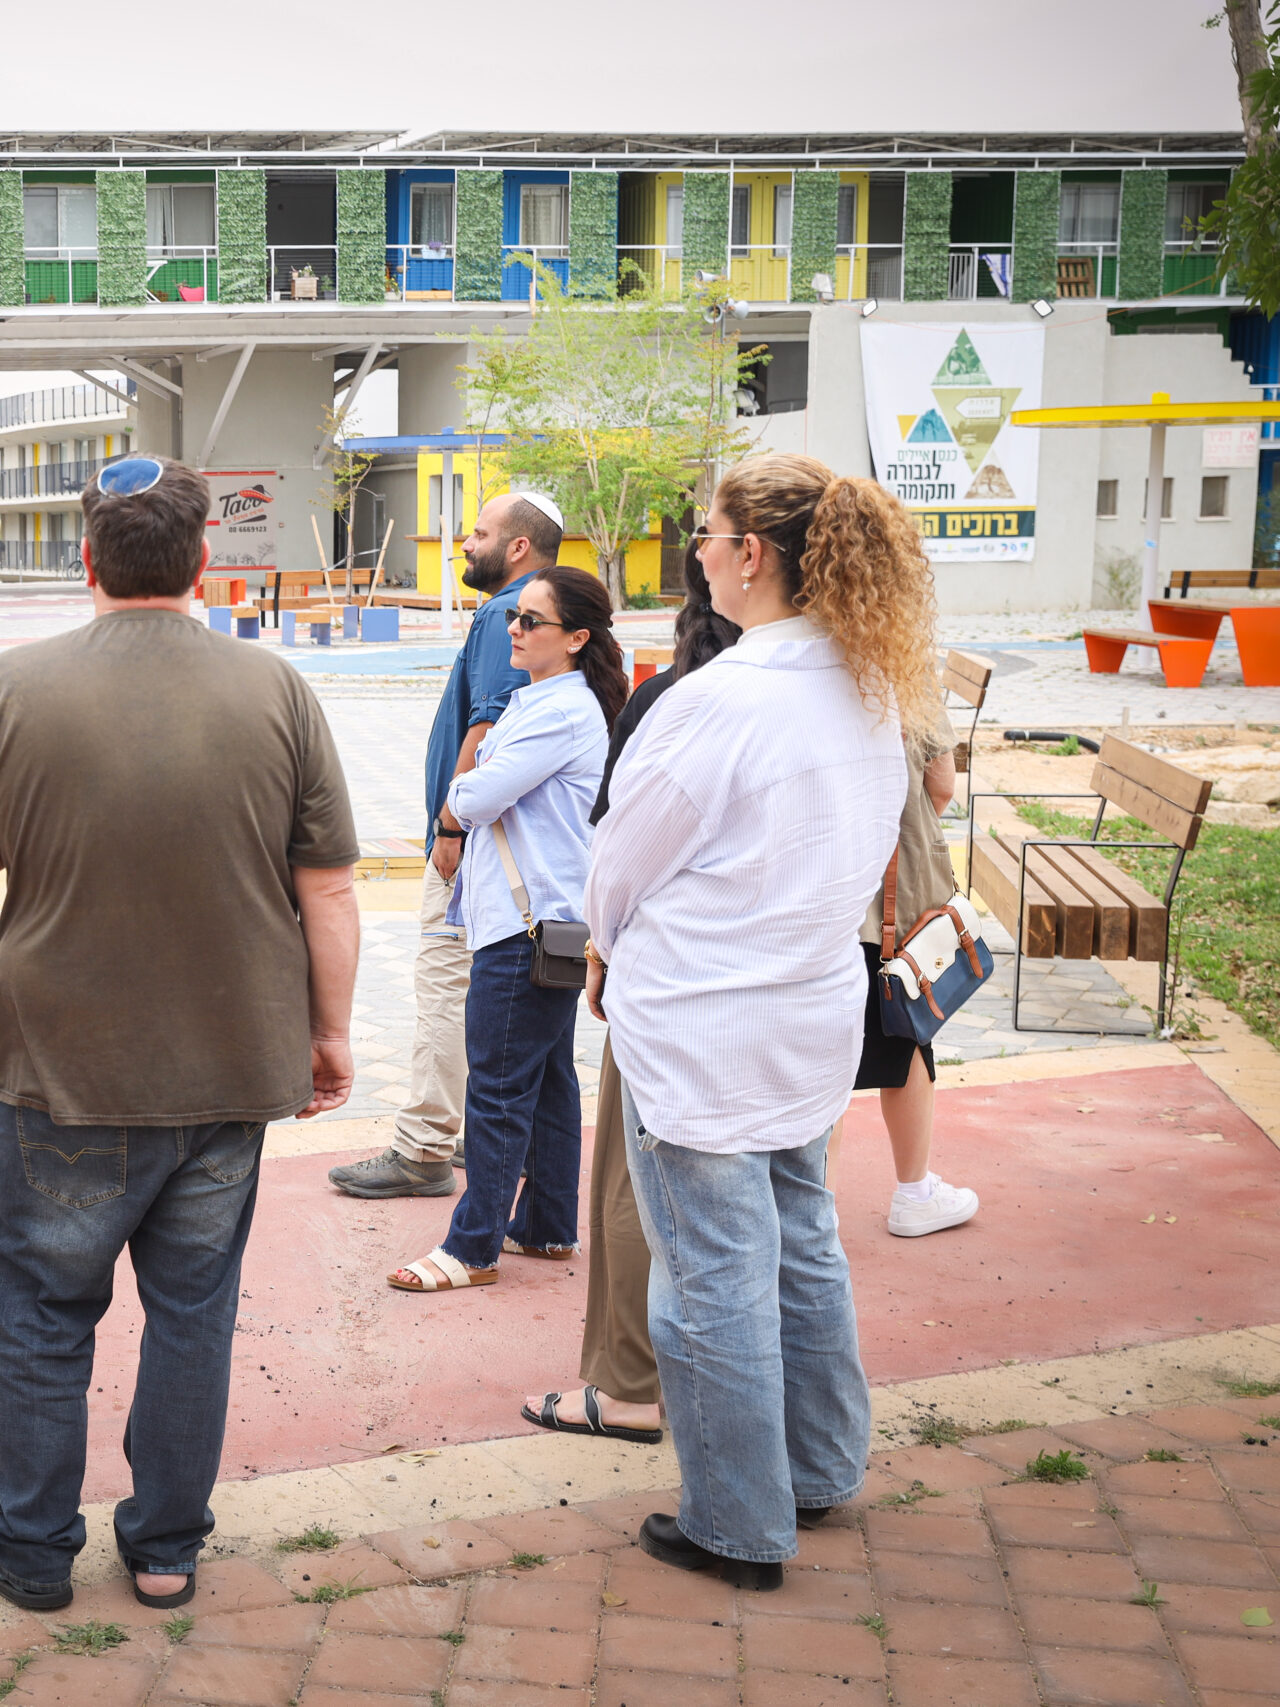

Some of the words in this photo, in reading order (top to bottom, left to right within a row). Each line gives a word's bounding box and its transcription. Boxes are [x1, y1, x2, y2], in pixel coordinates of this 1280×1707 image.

[887, 450, 941, 480] לגבורה
[897, 449, 930, 462] איילים
[938, 450, 958, 462] כנס
[897, 483, 955, 503] ותקומה
[219, 492, 264, 518] Taco
[946, 513, 1019, 536] ברוכים
